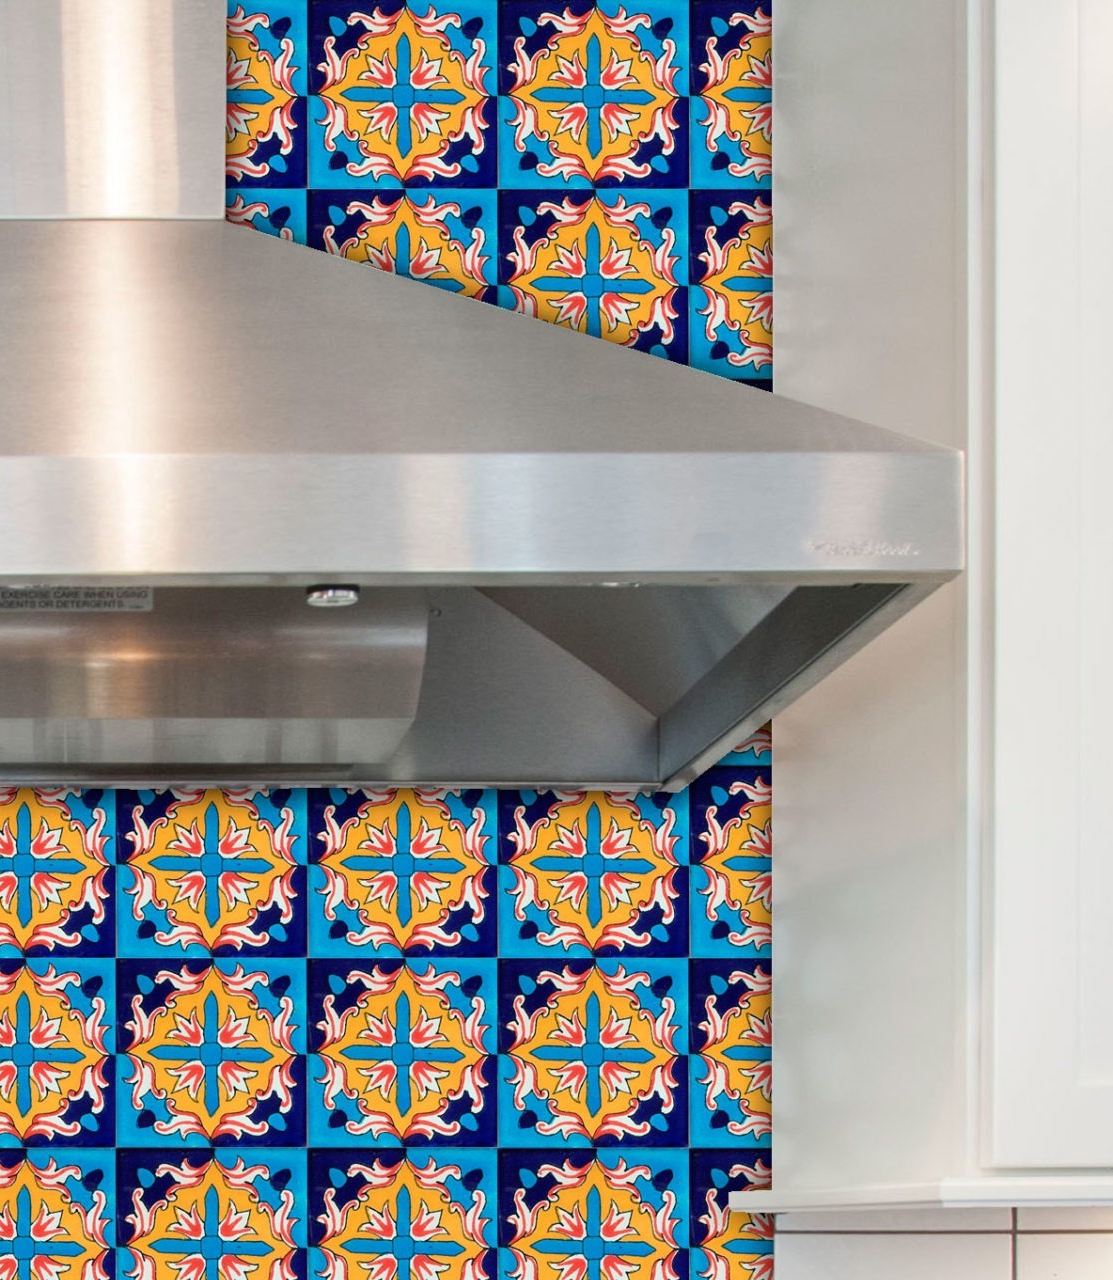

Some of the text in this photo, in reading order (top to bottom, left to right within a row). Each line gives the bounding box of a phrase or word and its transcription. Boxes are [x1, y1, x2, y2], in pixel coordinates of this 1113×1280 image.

[53, 590, 80, 599] CARE
[84, 590, 114, 599] WHEN
[117, 590, 148, 599] USING
[38, 599, 53, 609] OR
